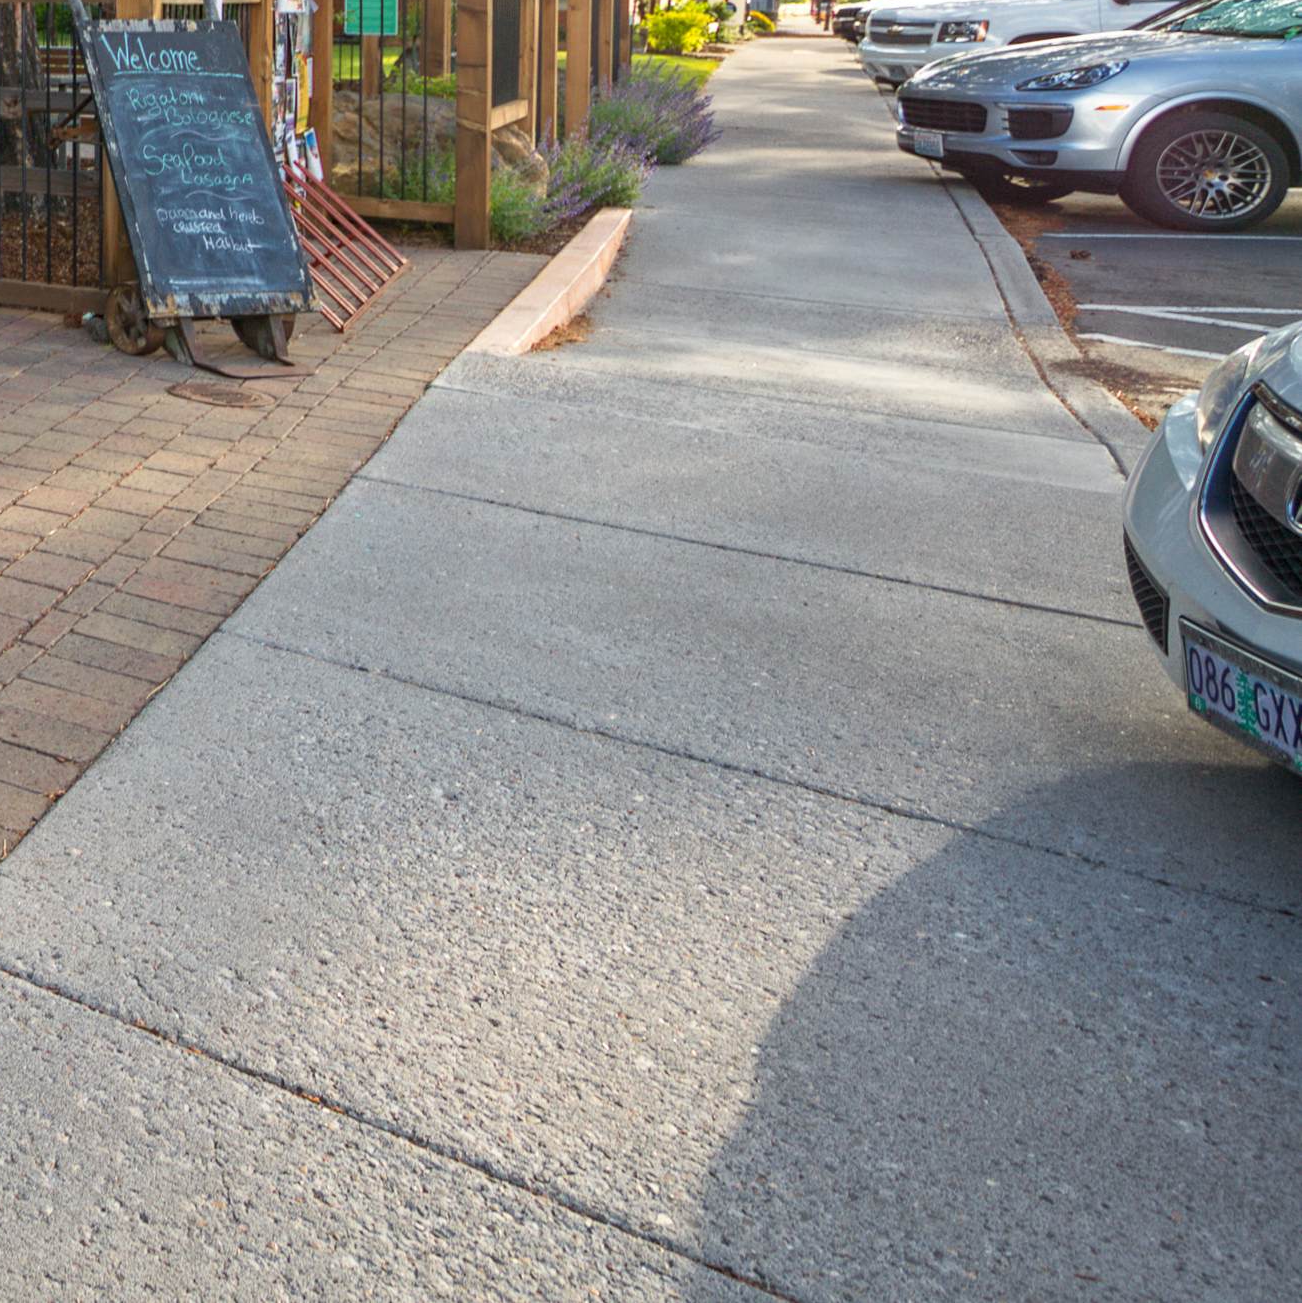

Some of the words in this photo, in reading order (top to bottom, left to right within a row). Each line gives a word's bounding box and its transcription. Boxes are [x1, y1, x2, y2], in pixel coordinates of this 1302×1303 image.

[99, 31, 201, 72] Welcome
[163, 104, 255, 130] Bolognese
[143, 142, 228, 176] Seafood
[1189, 647, 1236, 713] 086
